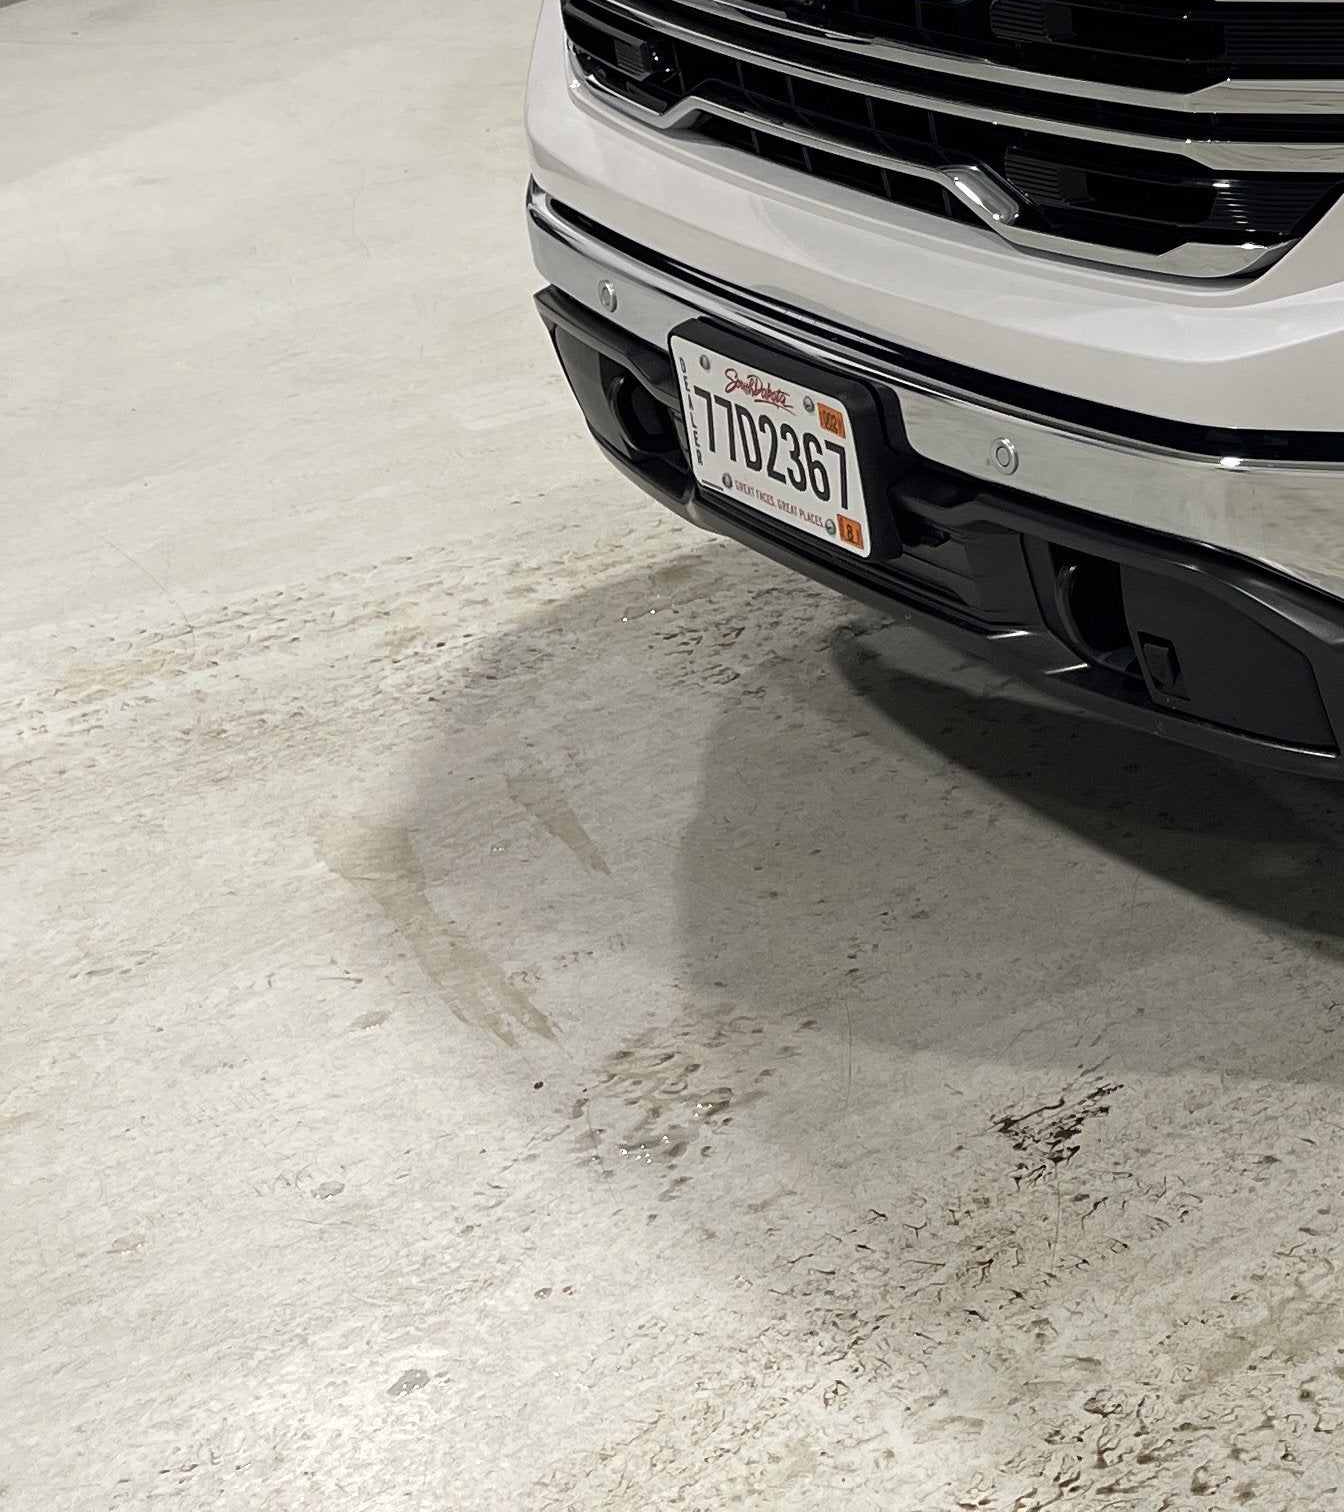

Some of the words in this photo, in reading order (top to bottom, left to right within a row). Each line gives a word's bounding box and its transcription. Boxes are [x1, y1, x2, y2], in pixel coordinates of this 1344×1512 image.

[679, 356, 703, 466] DEALER
[694, 385, 849, 510] 77D2367
[734, 479, 755, 497] GREAT
[776, 498, 798, 516] GREAT
